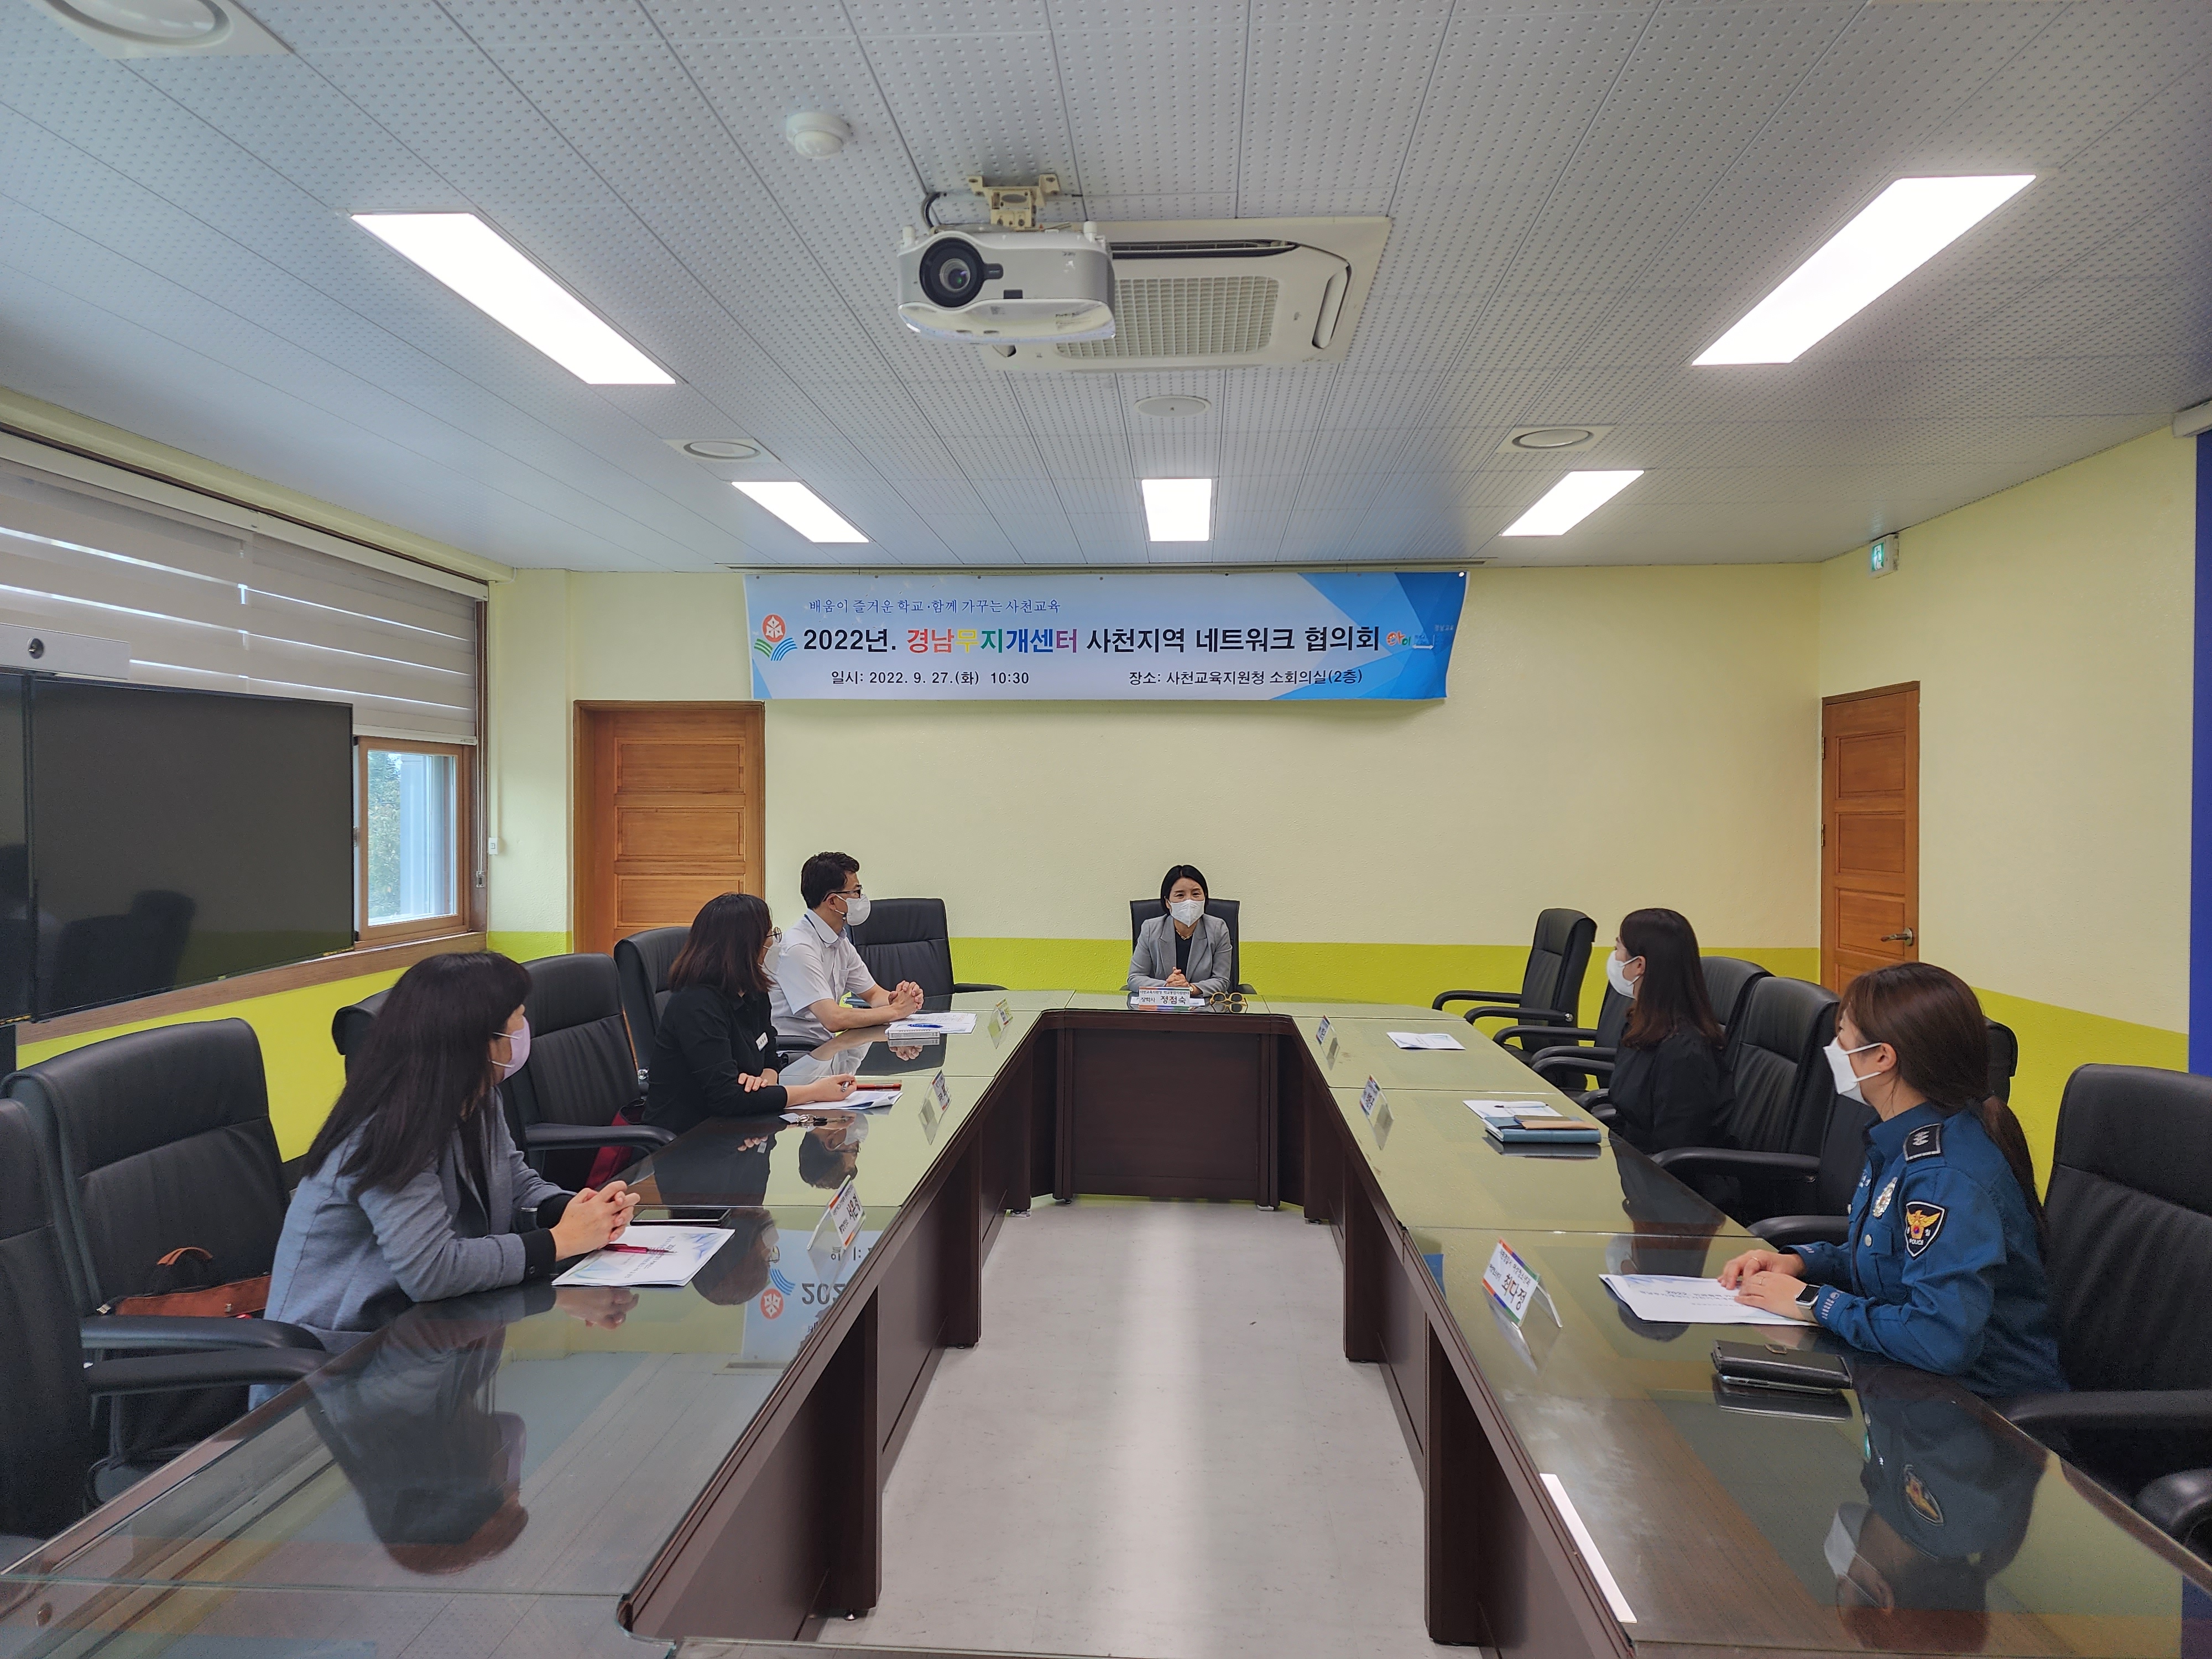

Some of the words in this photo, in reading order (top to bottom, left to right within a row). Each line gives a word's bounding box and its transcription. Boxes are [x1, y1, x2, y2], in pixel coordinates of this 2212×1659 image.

[809, 599, 848, 613] 배움이
[852, 599, 894, 613] 즐거운
[962, 599, 1003, 614] 가꾸는
[1005, 599, 1061, 614] 사천교육
[804, 629, 896, 653] 2022년.
[907, 628, 1077, 654] 경남무지개센터
[1087, 628, 1185, 653] 사천지역
[1196, 627, 1295, 653] 네트워크
[1304, 626, 1379, 653] 협의회
[831, 671, 864, 685] 일시:
[869, 672, 907, 684] 2022.
[914, 672, 926, 684] 9.
[991, 672, 1029, 684] 10:30
[1129, 671, 1161, 685] 장소:
[1166, 671, 1265, 685] 사천교육지원청
[1269, 669, 1363, 685] 소회의실(2층)
[1160, 995, 1186, 1004] 정점숙
[1501, 1273, 1528, 1311] 최다정
